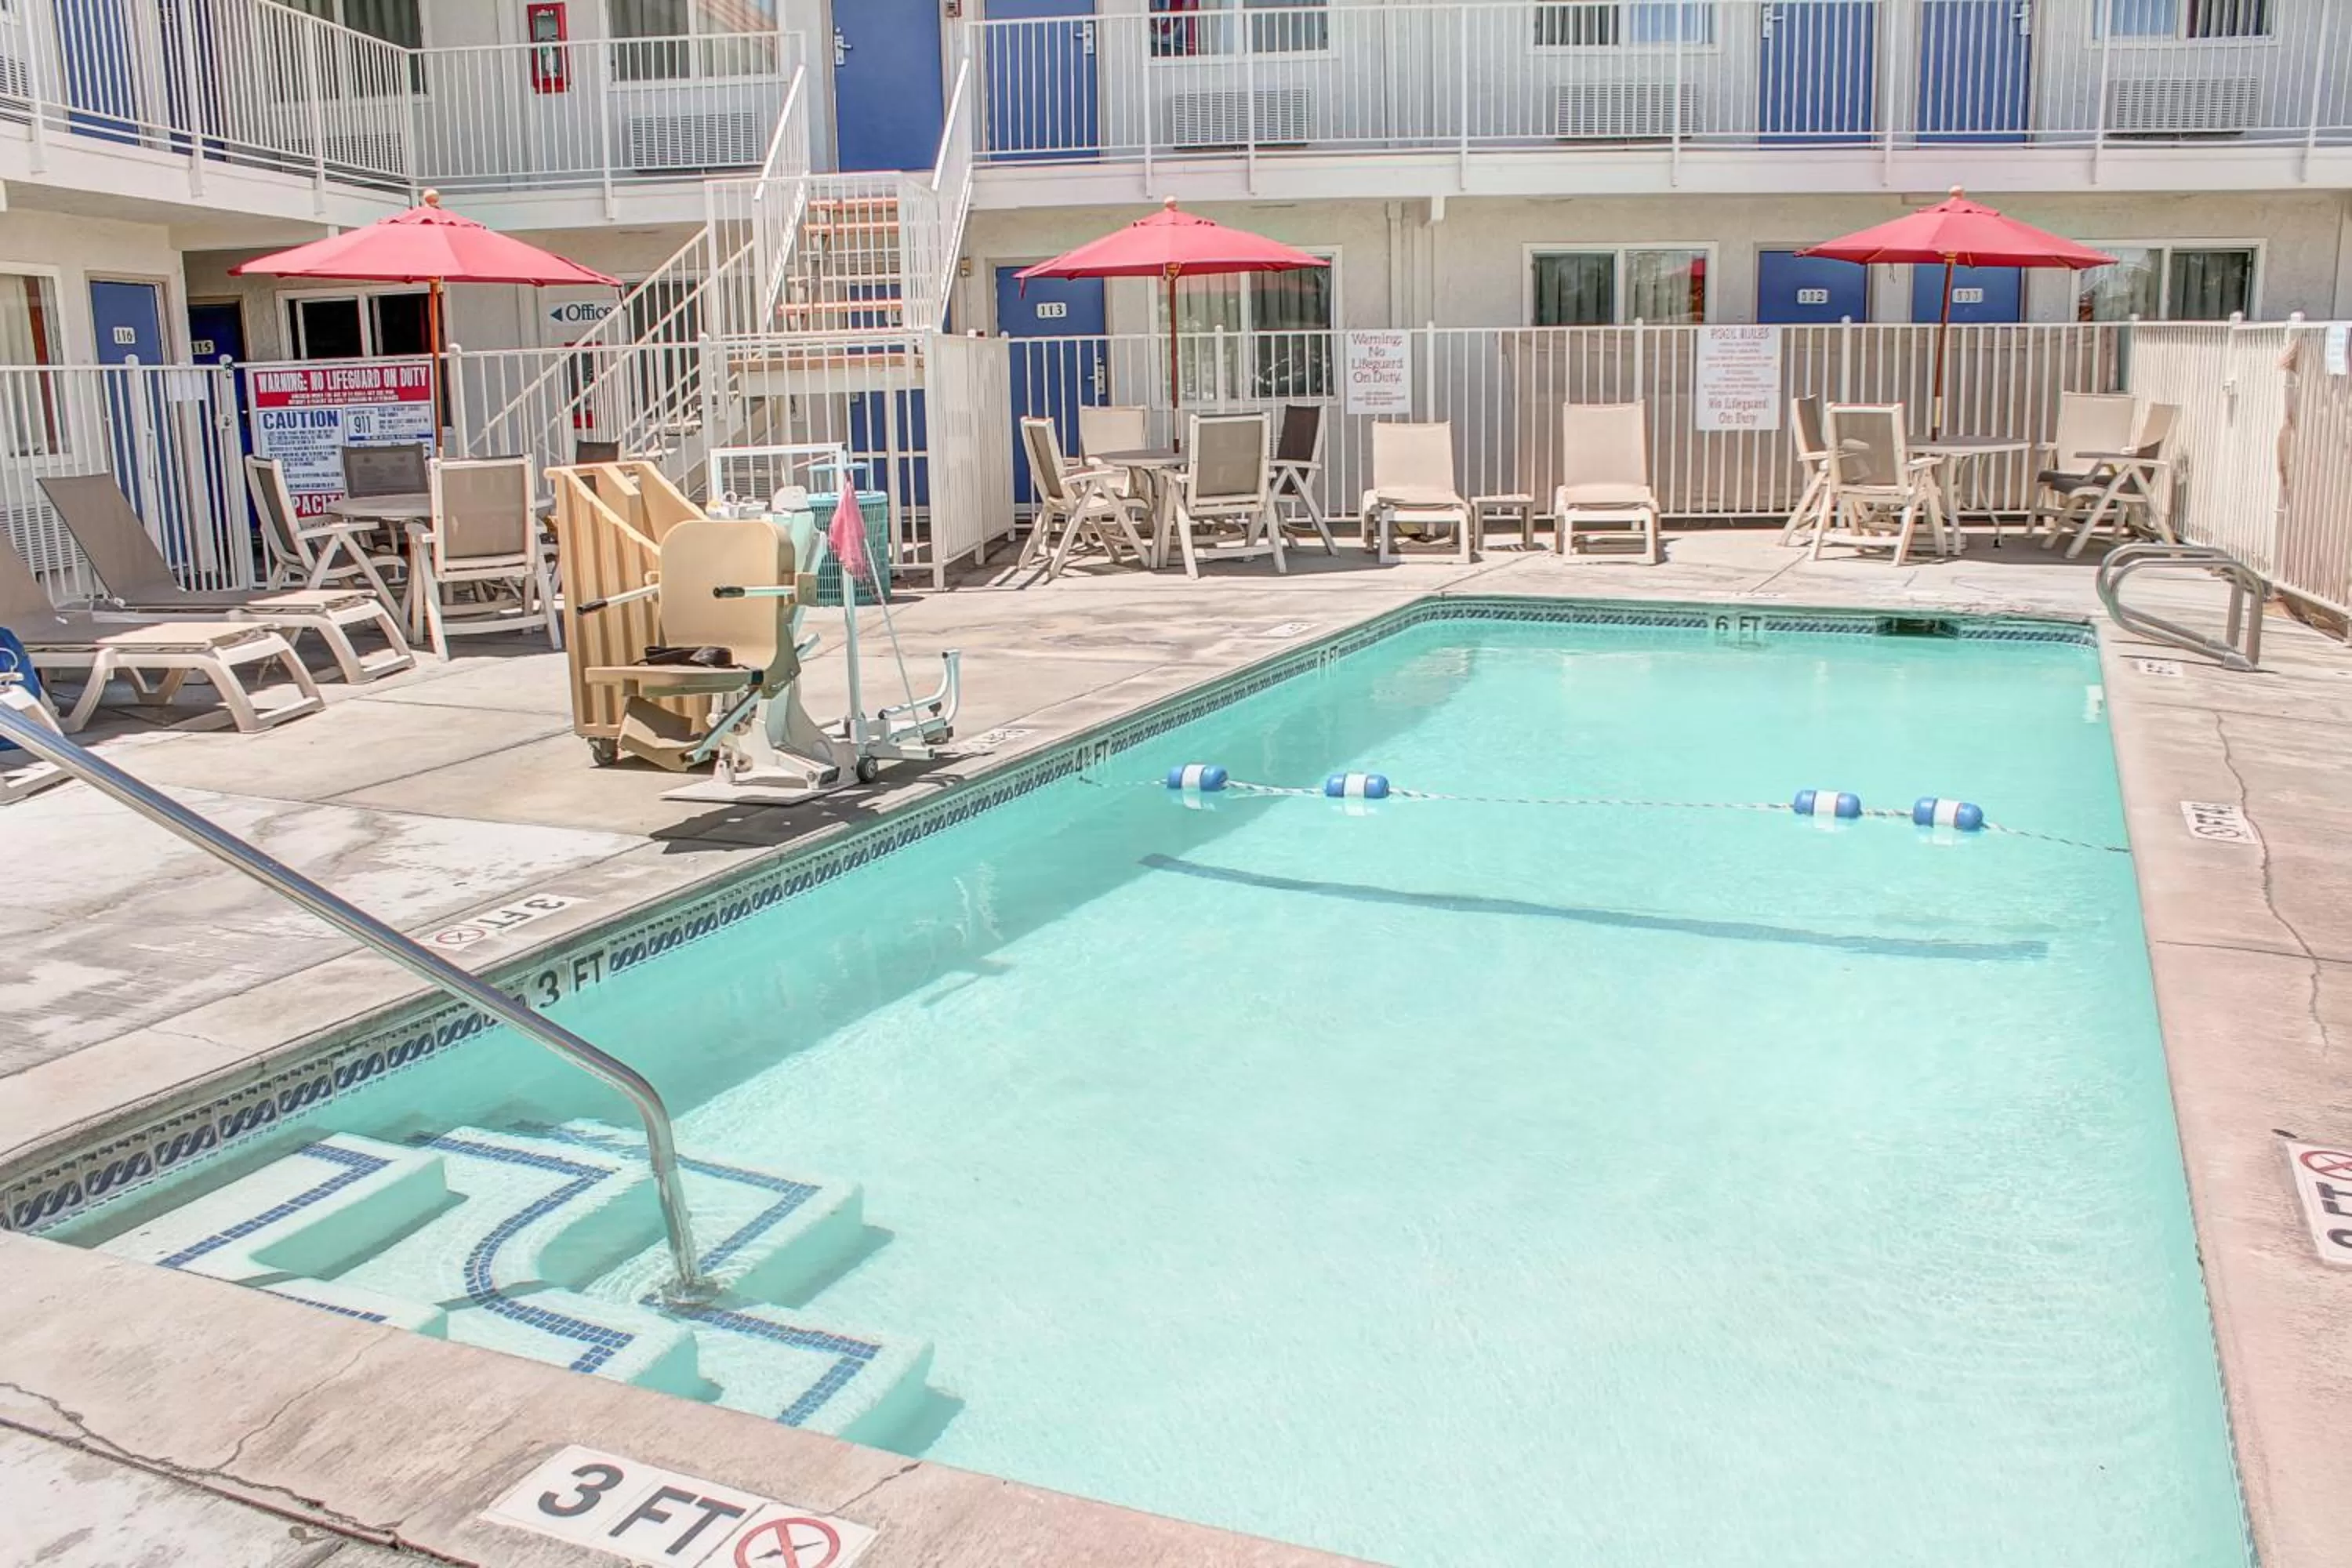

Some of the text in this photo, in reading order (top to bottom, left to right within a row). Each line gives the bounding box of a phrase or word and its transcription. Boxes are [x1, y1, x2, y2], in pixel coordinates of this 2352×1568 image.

[1041, 304, 1062, 315] 113
[116, 330, 132, 343] 116
[1368, 347, 1386, 357] No
[1352, 358, 1403, 373] Lifeguard
[257, 366, 427, 393] WARNING: NO LIFEGUARD ON DUTY
[1353, 372, 1371, 383] On
[263, 410, 339, 430] CAUTION
[354, 416, 372, 434] 911
[1715, 614, 1762, 631] 6 FT
[1094, 739, 1109, 766] FT
[476, 898, 566, 929] 3 FT
[538, 949, 604, 1009] 3 FT
[537, 1463, 747, 1556] 3 FT
